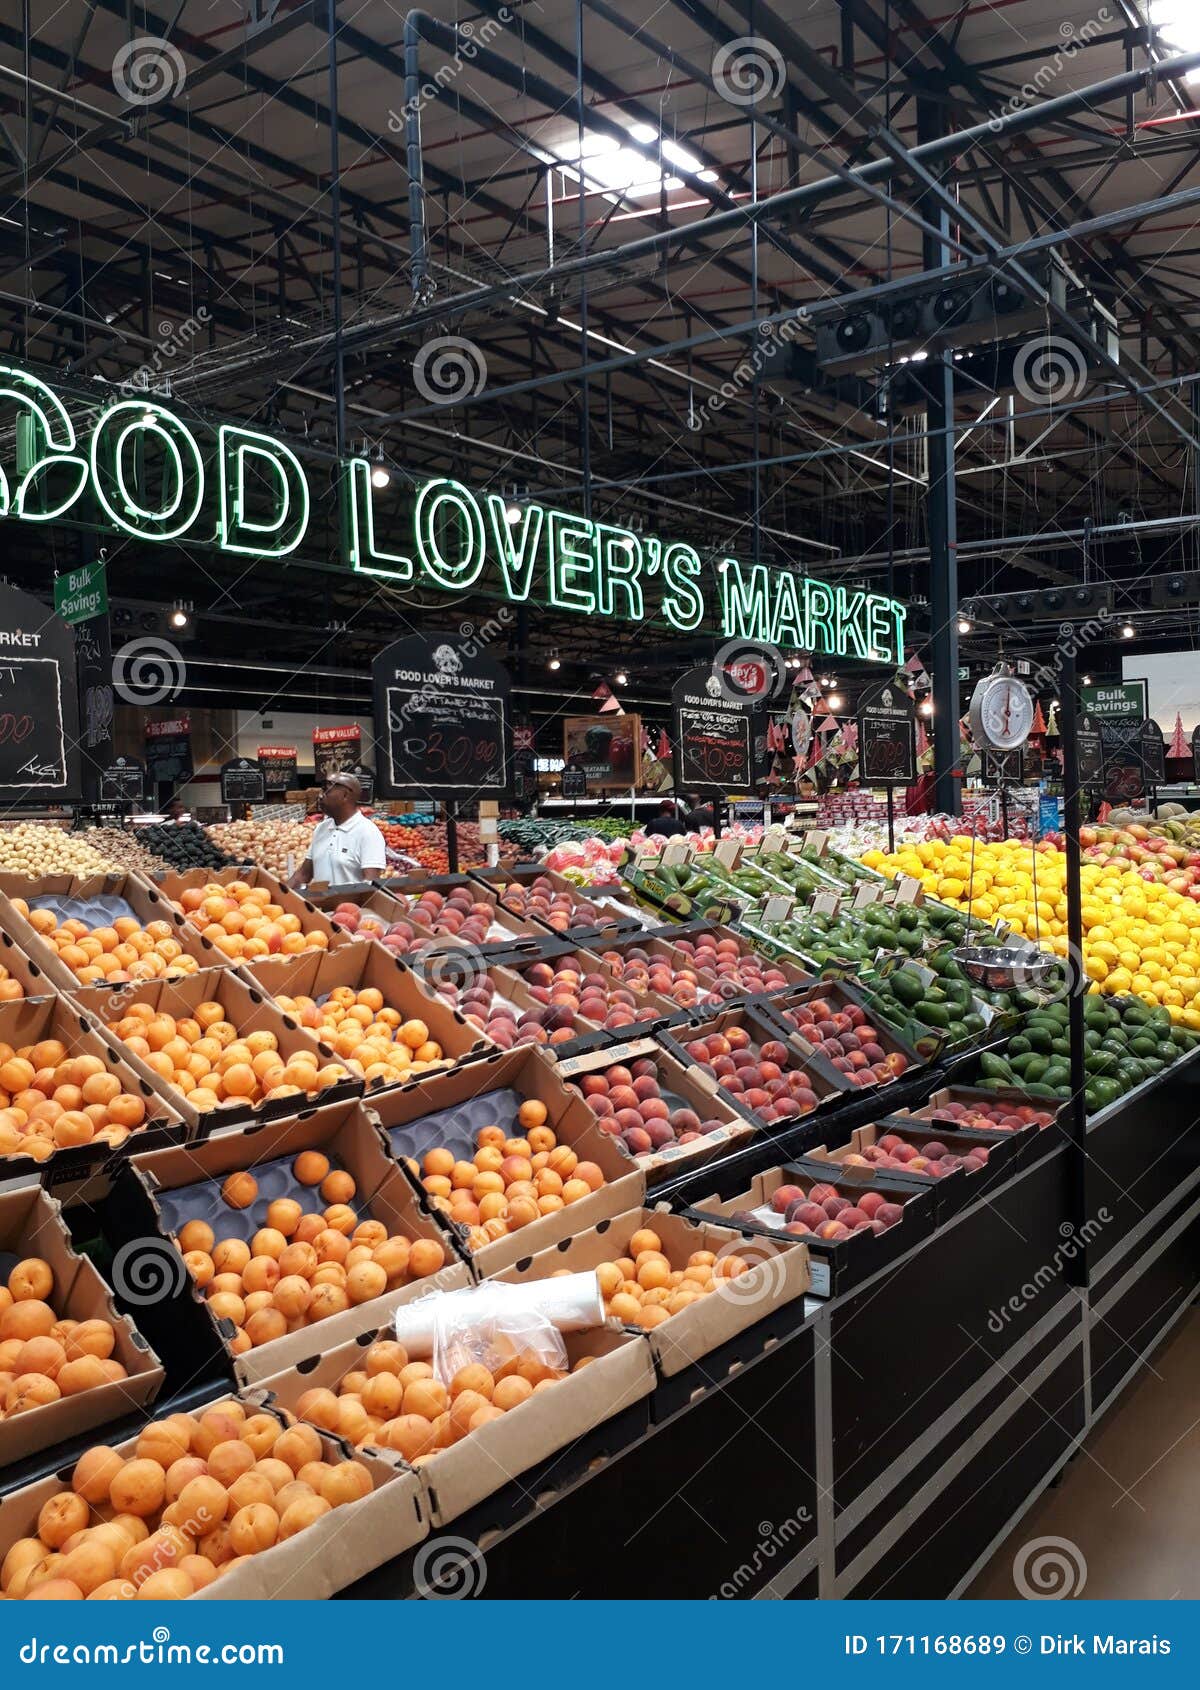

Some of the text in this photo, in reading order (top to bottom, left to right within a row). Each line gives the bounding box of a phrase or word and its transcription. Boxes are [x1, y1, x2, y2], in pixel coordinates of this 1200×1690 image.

[351, 459, 705, 631] LOVER'S
[720, 559, 907, 666] MARKET
[68, 568, 92, 592] Bulk
[60, 591, 101, 617] Savings
[395, 669, 495, 690] FOOD LOVER'S MARKET
[684, 694, 743, 711] FOOD LOVER'S MARKET
[1096, 689, 1126, 701] Bulk
[1086, 700, 1138, 714] Savings
[319, 727, 357, 740] WE VALUE
